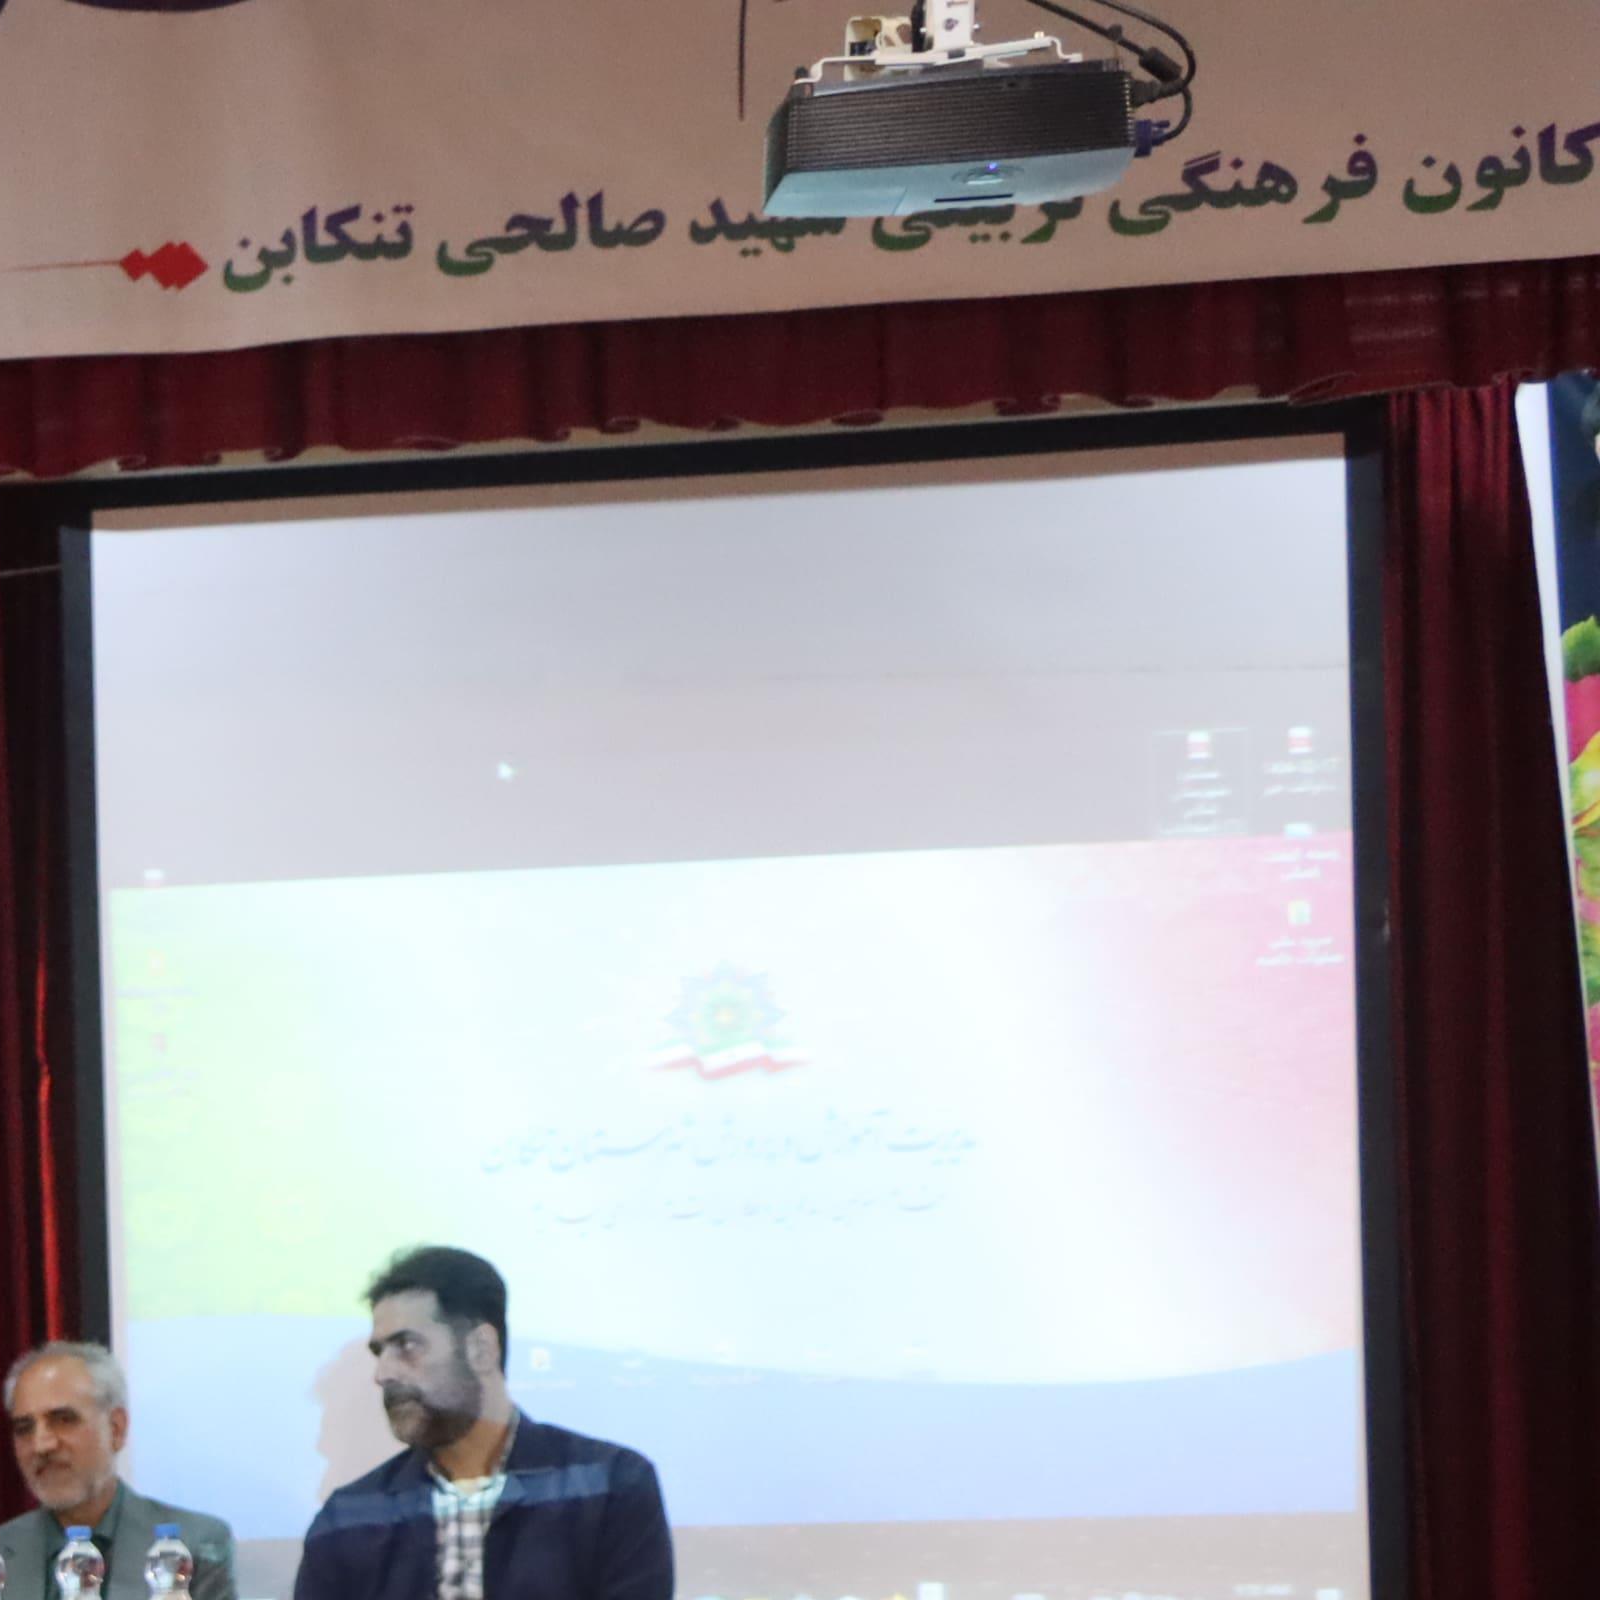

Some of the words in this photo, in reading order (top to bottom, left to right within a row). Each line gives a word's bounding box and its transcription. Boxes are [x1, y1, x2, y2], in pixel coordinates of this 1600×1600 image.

[1108, 132, 1379, 236] فرهنگی
[1403, 121, 1600, 214] کانون
[221, 203, 415, 293] تنکابن
[436, 189, 667, 277] صالحی
